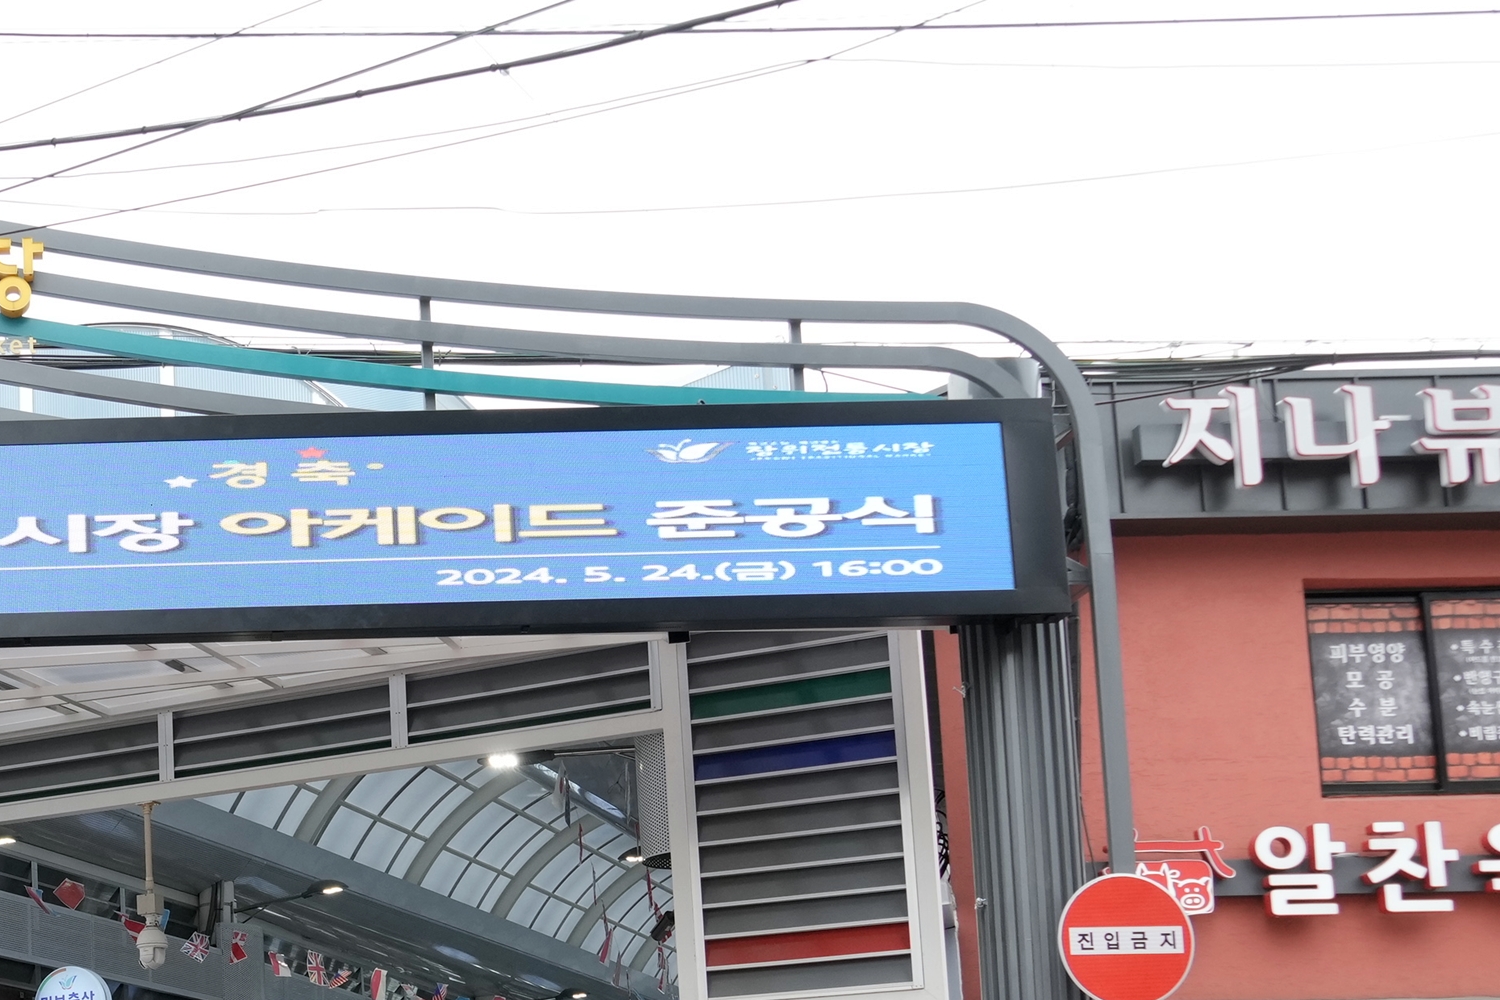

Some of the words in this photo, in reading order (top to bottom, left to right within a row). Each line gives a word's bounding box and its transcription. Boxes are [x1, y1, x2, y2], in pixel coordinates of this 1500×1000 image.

[219, 503, 618, 548] 아케이드
[646, 494, 935, 539] 준공식
[436, 567, 567, 586] 2024.
[583, 566, 626, 583] 5.
[642, 560, 796, 582] 24.(금)
[812, 558, 943, 577] 16:00
[1329, 642, 1406, 664] 피부영양
[1337, 724, 1414, 745] 탄력관리
[1077, 930, 1178, 951] 진입금지
